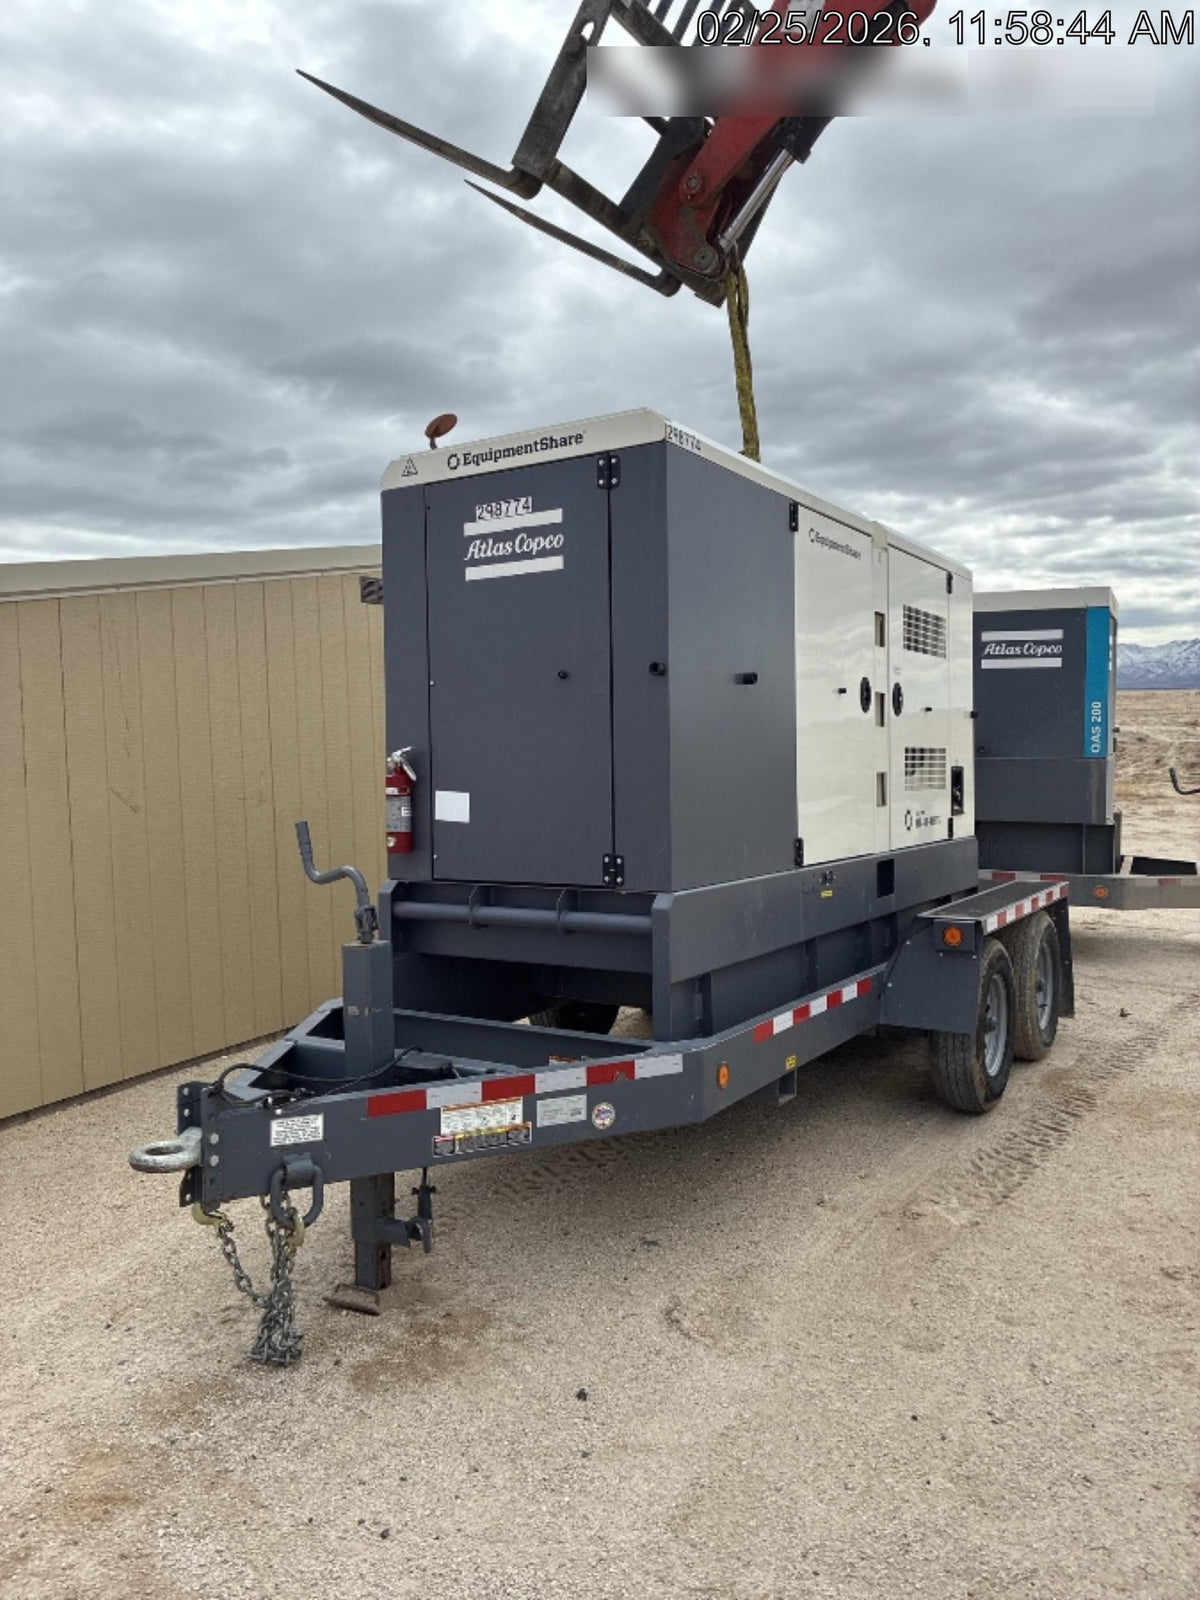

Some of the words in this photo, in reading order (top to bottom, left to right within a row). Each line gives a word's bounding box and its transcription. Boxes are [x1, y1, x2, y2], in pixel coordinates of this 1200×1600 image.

[462, 432, 584, 466] EquipmentShare
[476, 496, 531, 520] 298774
[464, 538, 513, 561] Atlas
[515, 533, 564, 555] Copco
[984, 643, 1022, 656] Atlas
[1023, 642, 1062, 656] Copco
[1092, 701, 1102, 723] 200
